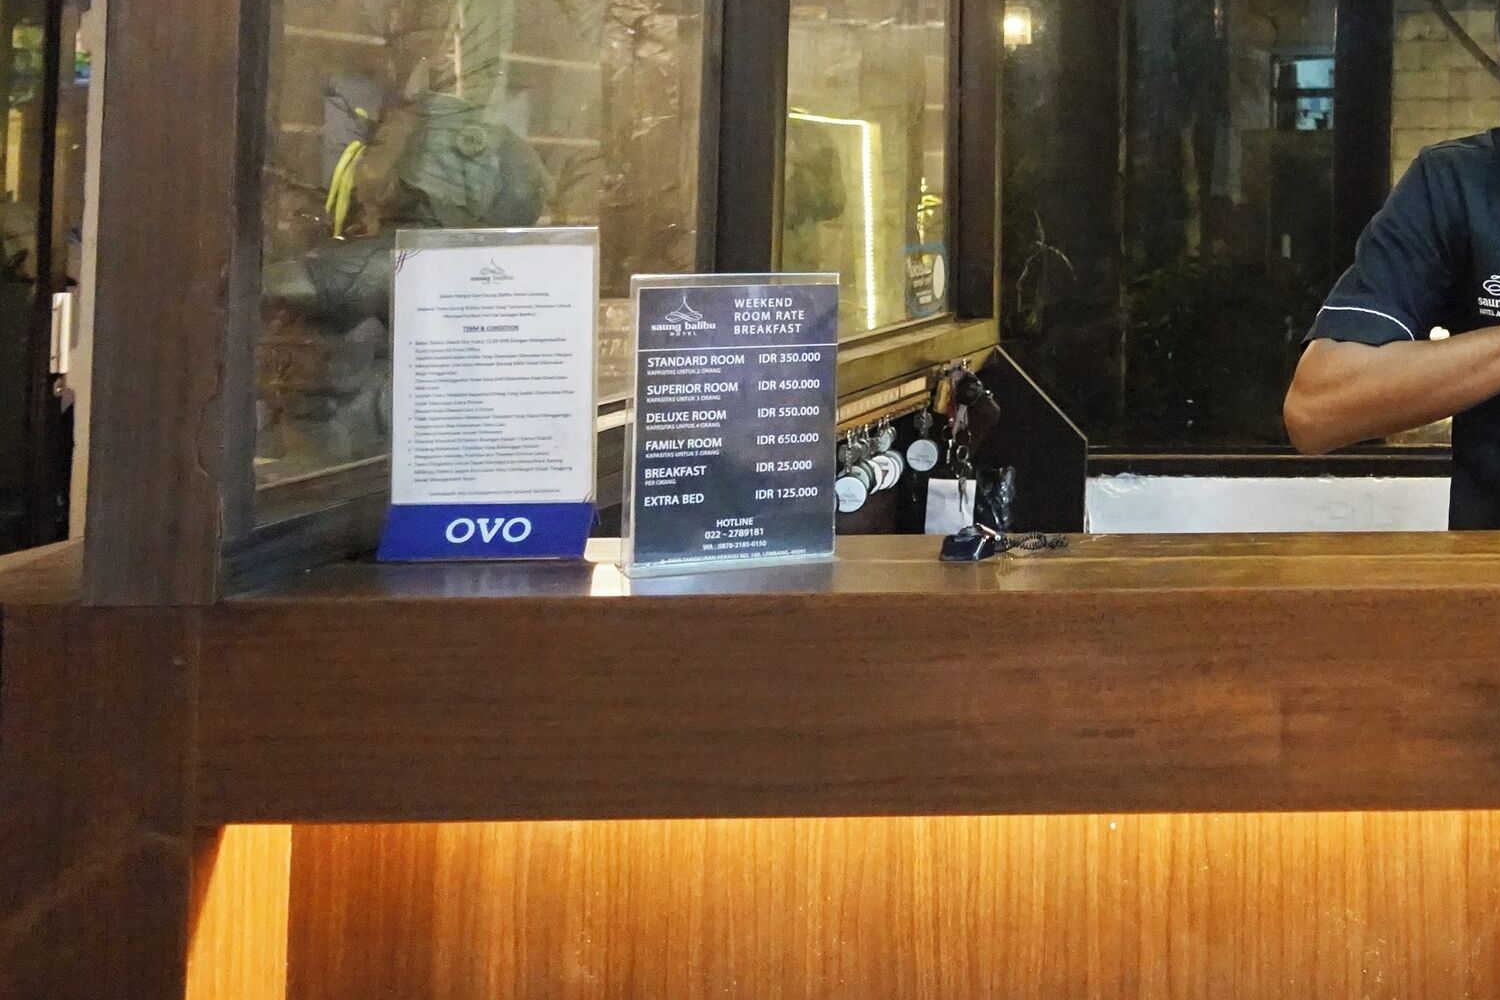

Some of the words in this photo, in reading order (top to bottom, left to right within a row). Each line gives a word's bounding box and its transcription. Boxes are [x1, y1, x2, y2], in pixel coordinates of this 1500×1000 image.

[734, 297, 793, 308] WEEKEND
[734, 310, 772, 321] ROOM
[775, 310, 805, 320] RATE
[651, 323, 682, 332] saung
[684, 321, 717, 330] balibu
[734, 323, 802, 335] BREAKFAST
[647, 356, 708, 368] STANDARD
[710, 354, 745, 365] ROOM
[758, 354, 778, 364] IDR
[779, 352, 821, 363] 350.000
[647, 384, 702, 396] SUPERIOR
[704, 382, 738, 393] ROOM
[758, 380, 777, 391] IDR
[779, 379, 820, 390] 450.000
[646, 411, 689, 423] DELUXE
[692, 410, 727, 421] ROOM
[757, 407, 777, 418] IDR
[778, 406, 820, 417] 550.000
[645, 439, 685, 451] FAMILY
[687, 438, 722, 449] ROOM
[757, 434, 776, 445] IDR
[778, 433, 819, 444] 650.000
[645, 465, 707, 479] BREAKFAST
[756, 462, 775, 472] IDR
[777, 460, 812, 472] 25.000
[644, 495, 680, 507] EXTRA
[682, 493, 704, 505] BED
[755, 489, 774, 500] IDR
[776, 487, 818, 498] 125.000
[445, 516, 532, 544] OVO
[716, 517, 754, 528] HOTLINE
[705, 529, 721, 540] 022
[728, 527, 764, 538] 2789181
